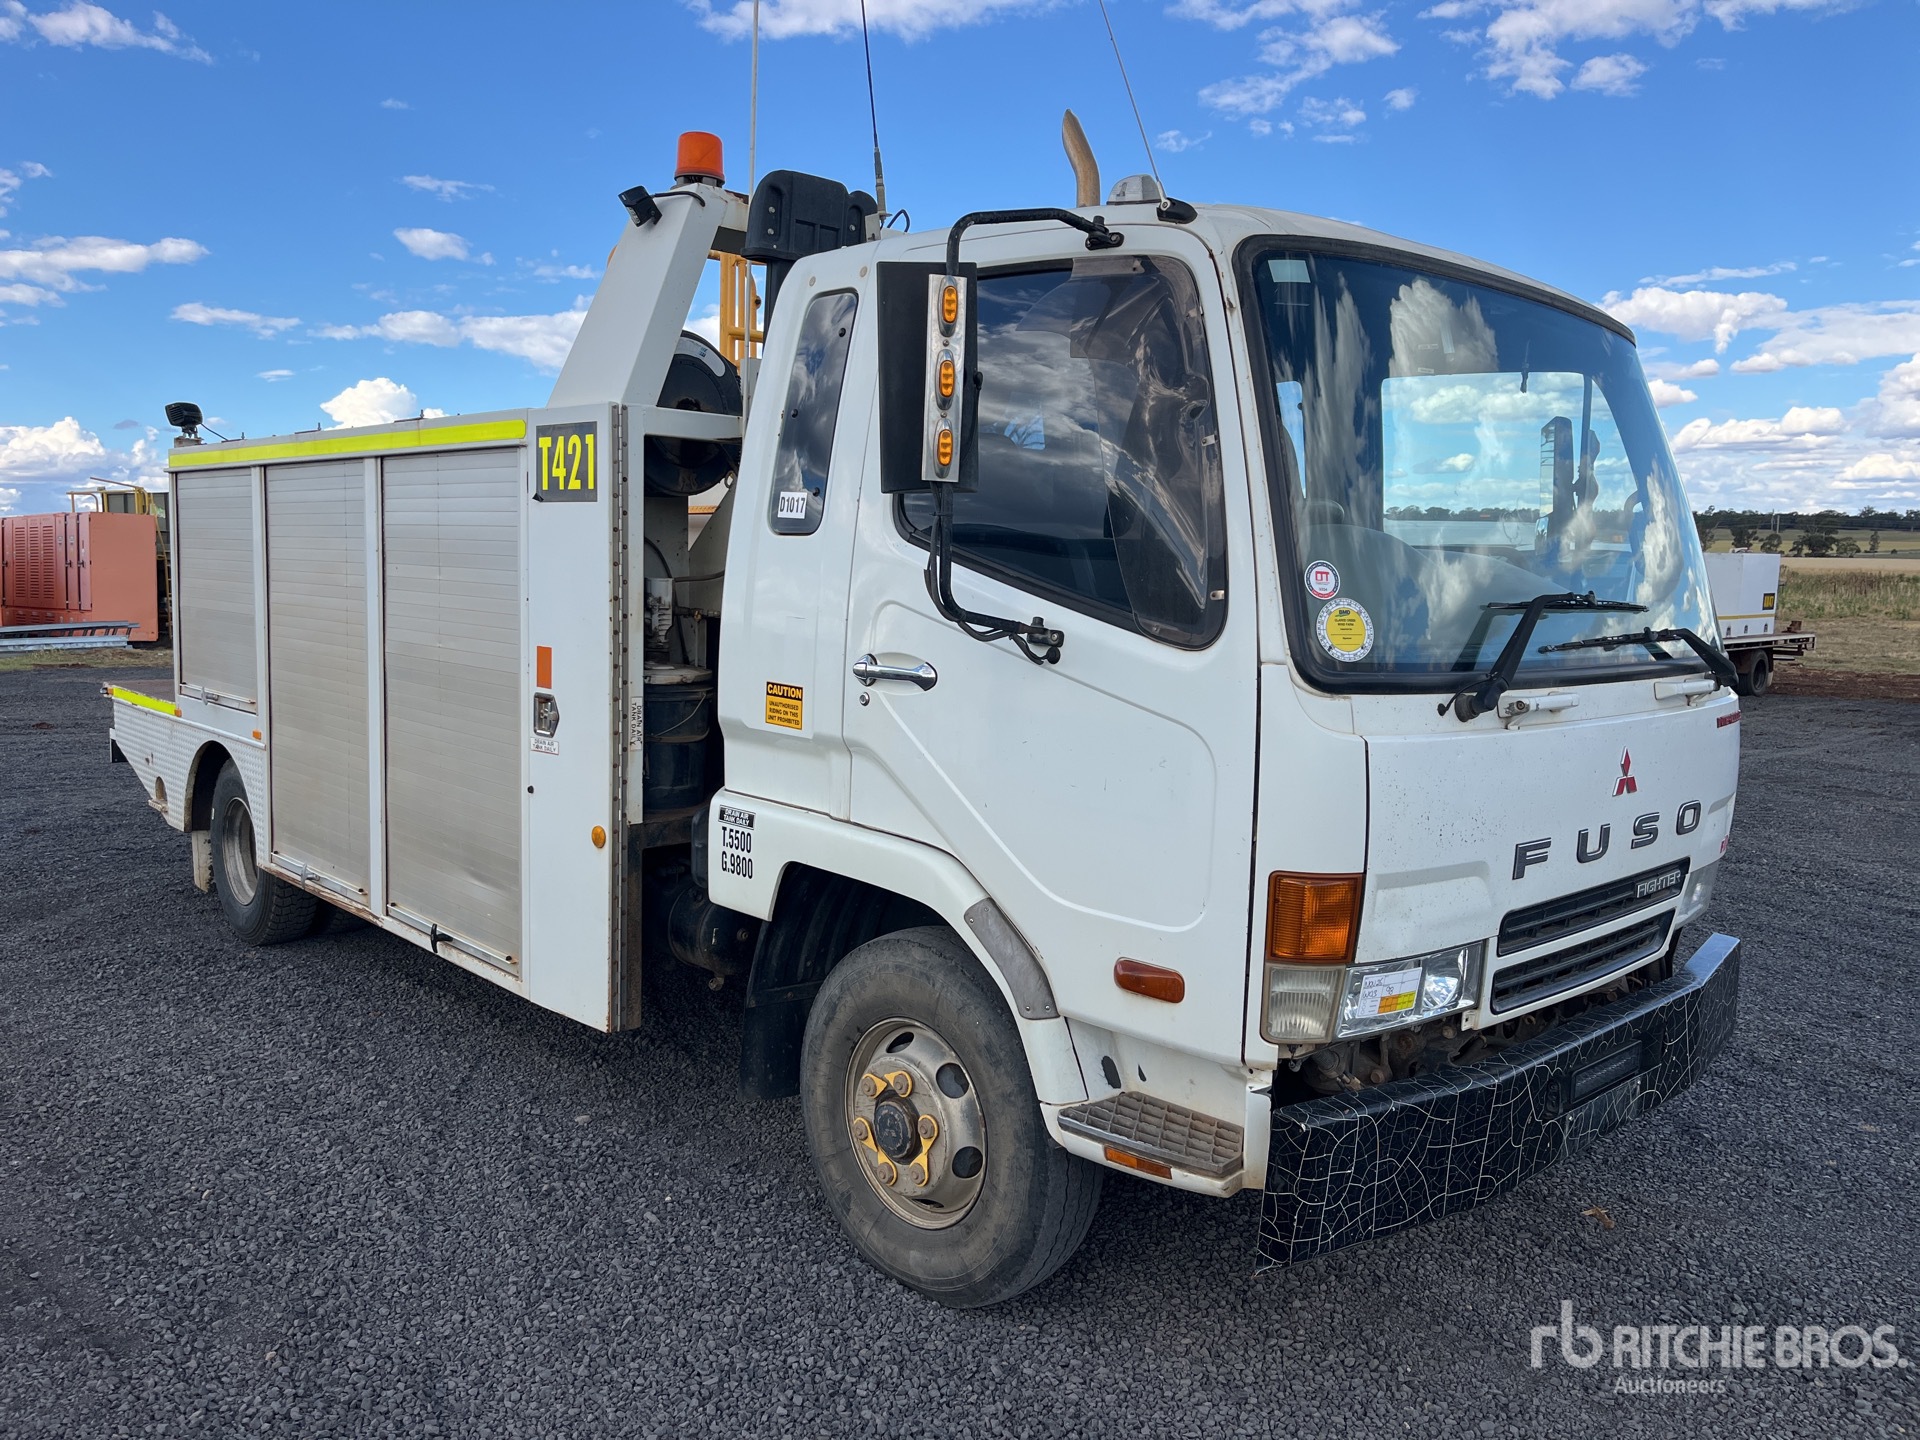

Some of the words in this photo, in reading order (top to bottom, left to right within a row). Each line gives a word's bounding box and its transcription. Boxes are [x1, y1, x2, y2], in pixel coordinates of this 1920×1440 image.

[538, 433, 595, 491] T421
[779, 496, 806, 514] D1017
[767, 683, 802, 700] CAUTION
[769, 700, 799, 711] UNAUTHORISED
[769, 707, 782, 715] RIDING
[790, 710, 799, 718] THIS
[777, 716, 800, 726] PROHIBITED
[723, 814, 736, 824] TANK
[736, 816, 750, 826] DAILY
[724, 808, 740, 818] DRAIN
[740, 812, 749, 820] AIR
[722, 826, 752, 854] T.5500
[1512, 799, 1702, 880] FUSO
[722, 850, 753, 880] G.9800
[1636, 869, 1682, 899] FIGHTER
